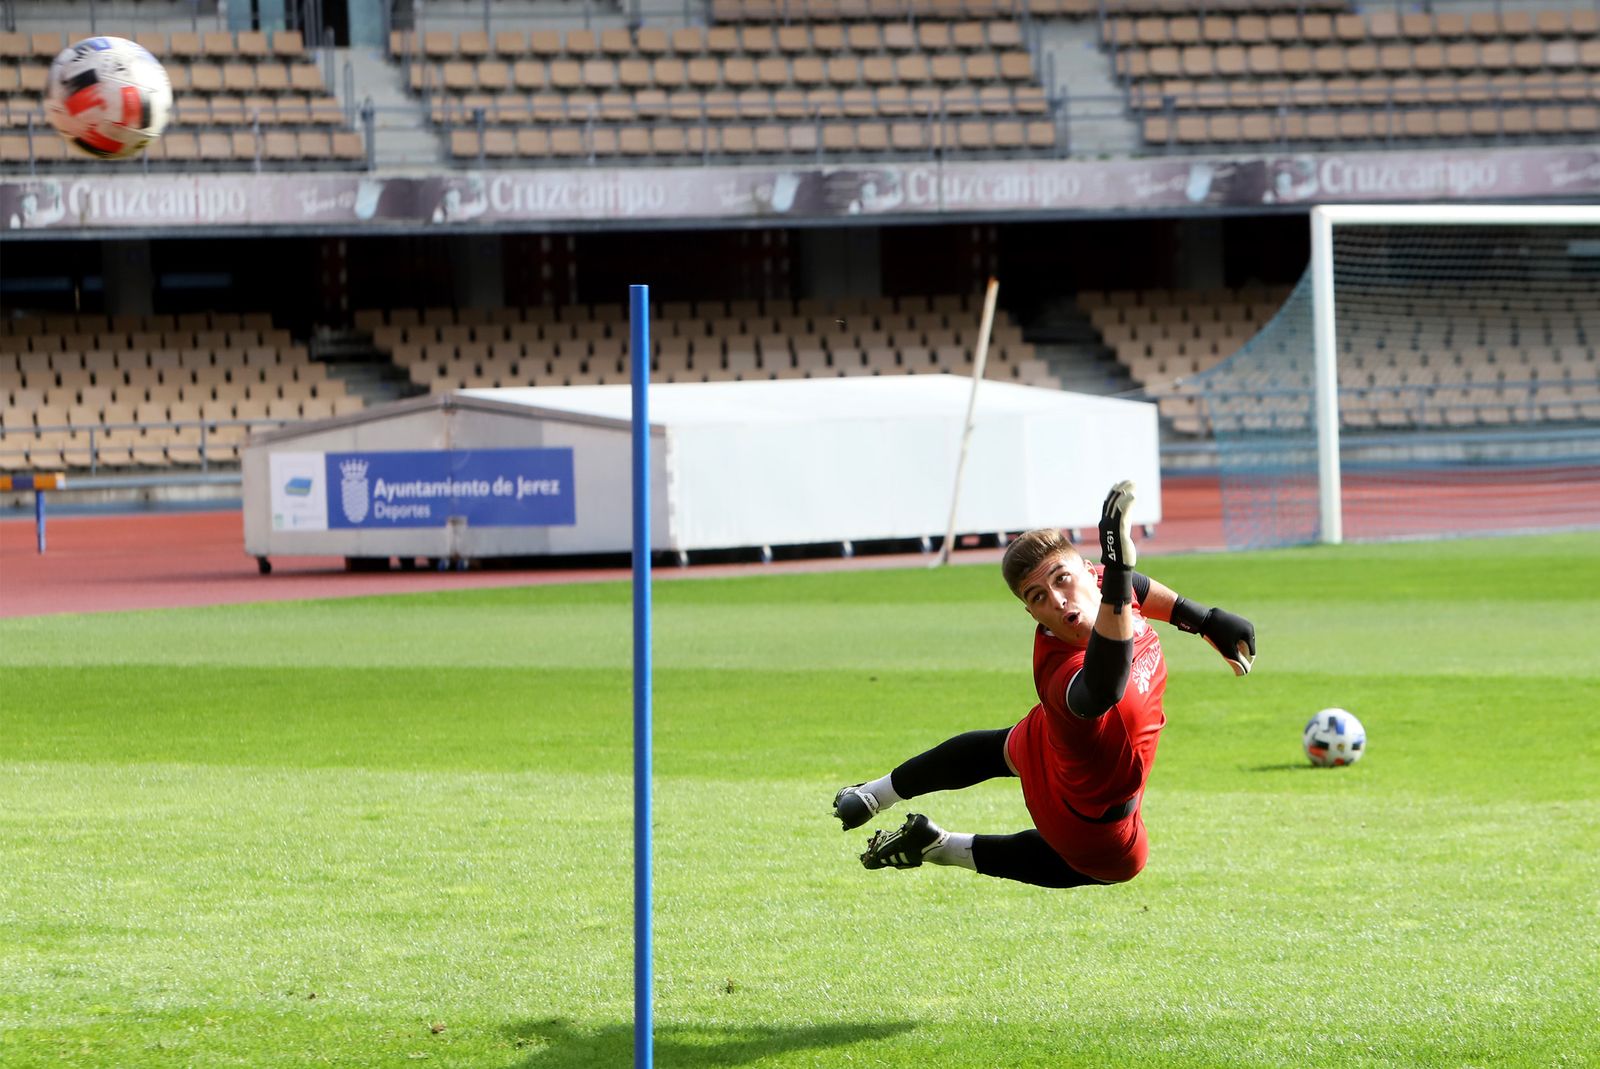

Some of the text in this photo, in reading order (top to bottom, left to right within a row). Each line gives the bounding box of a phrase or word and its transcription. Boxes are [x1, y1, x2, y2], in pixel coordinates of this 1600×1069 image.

[491, 174, 665, 215] Cruzcampo
[906, 168, 1079, 206] Cruzcampo
[1321, 158, 1496, 196] Cruzcampo
[69, 182, 246, 222] Cruzcampo
[373, 475, 560, 502] Ayuntamiento de Jerez
[373, 502, 431, 522] Deportes
